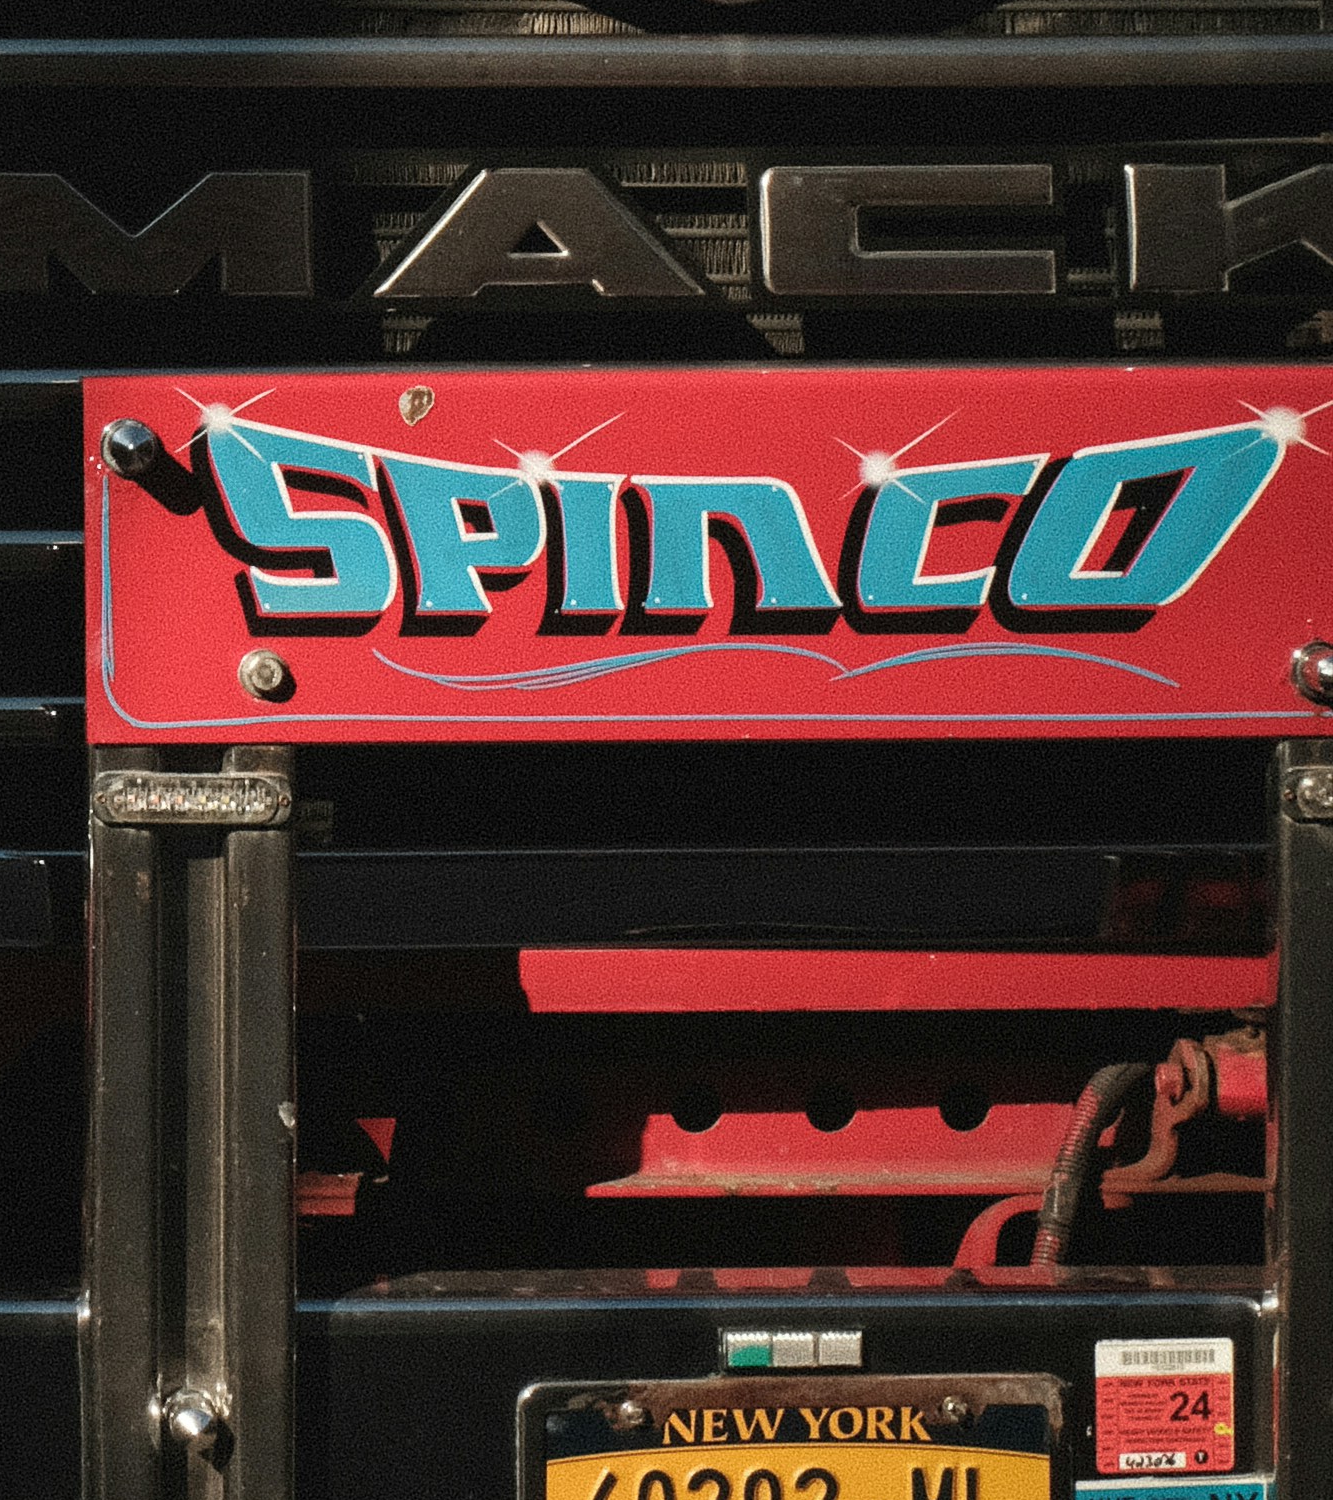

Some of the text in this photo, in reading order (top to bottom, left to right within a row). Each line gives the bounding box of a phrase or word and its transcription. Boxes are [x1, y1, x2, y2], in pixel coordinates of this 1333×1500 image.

[1169, 1390, 1212, 1422] 24
[662, 1404, 932, 1447] NEW YORK
